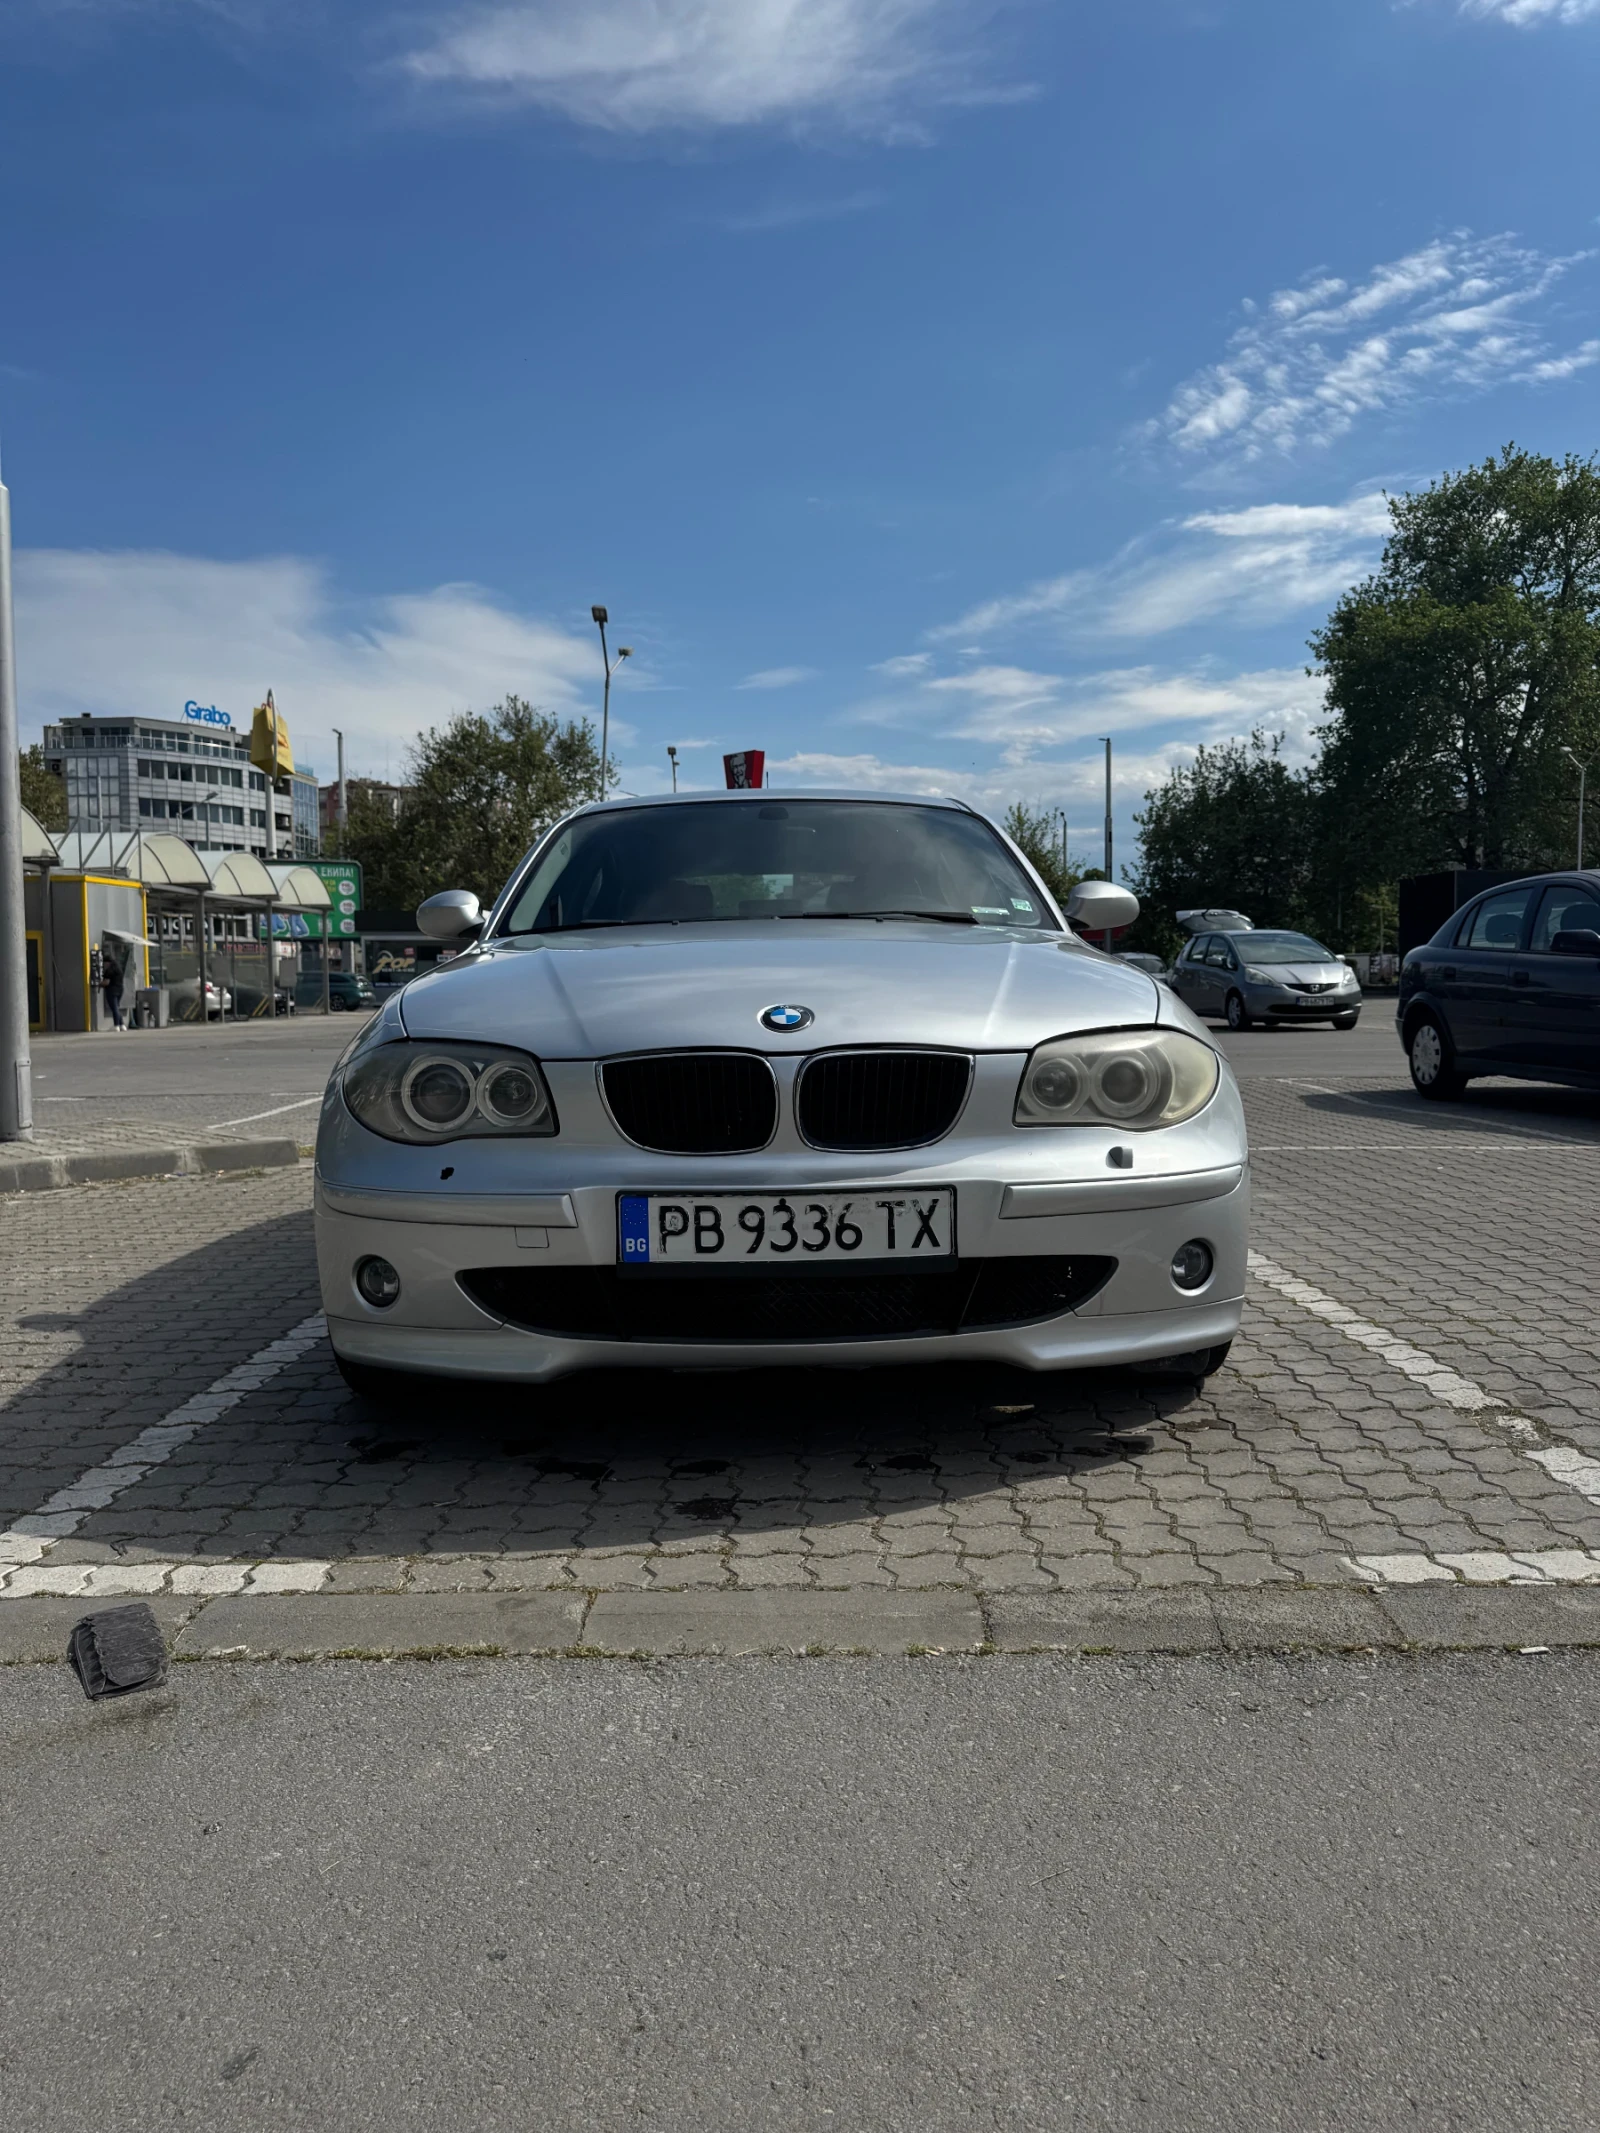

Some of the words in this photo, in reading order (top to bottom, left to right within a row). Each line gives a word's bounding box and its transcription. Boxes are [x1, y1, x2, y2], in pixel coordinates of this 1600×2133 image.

[185, 700, 231, 725] Grabo
[372, 955, 415, 974] TOP
[658, 1204, 725, 1254] PB
[738, 1203, 863, 1254] 9336
[876, 1199, 941, 1249] TX
[625, 1238, 646, 1252] BG
